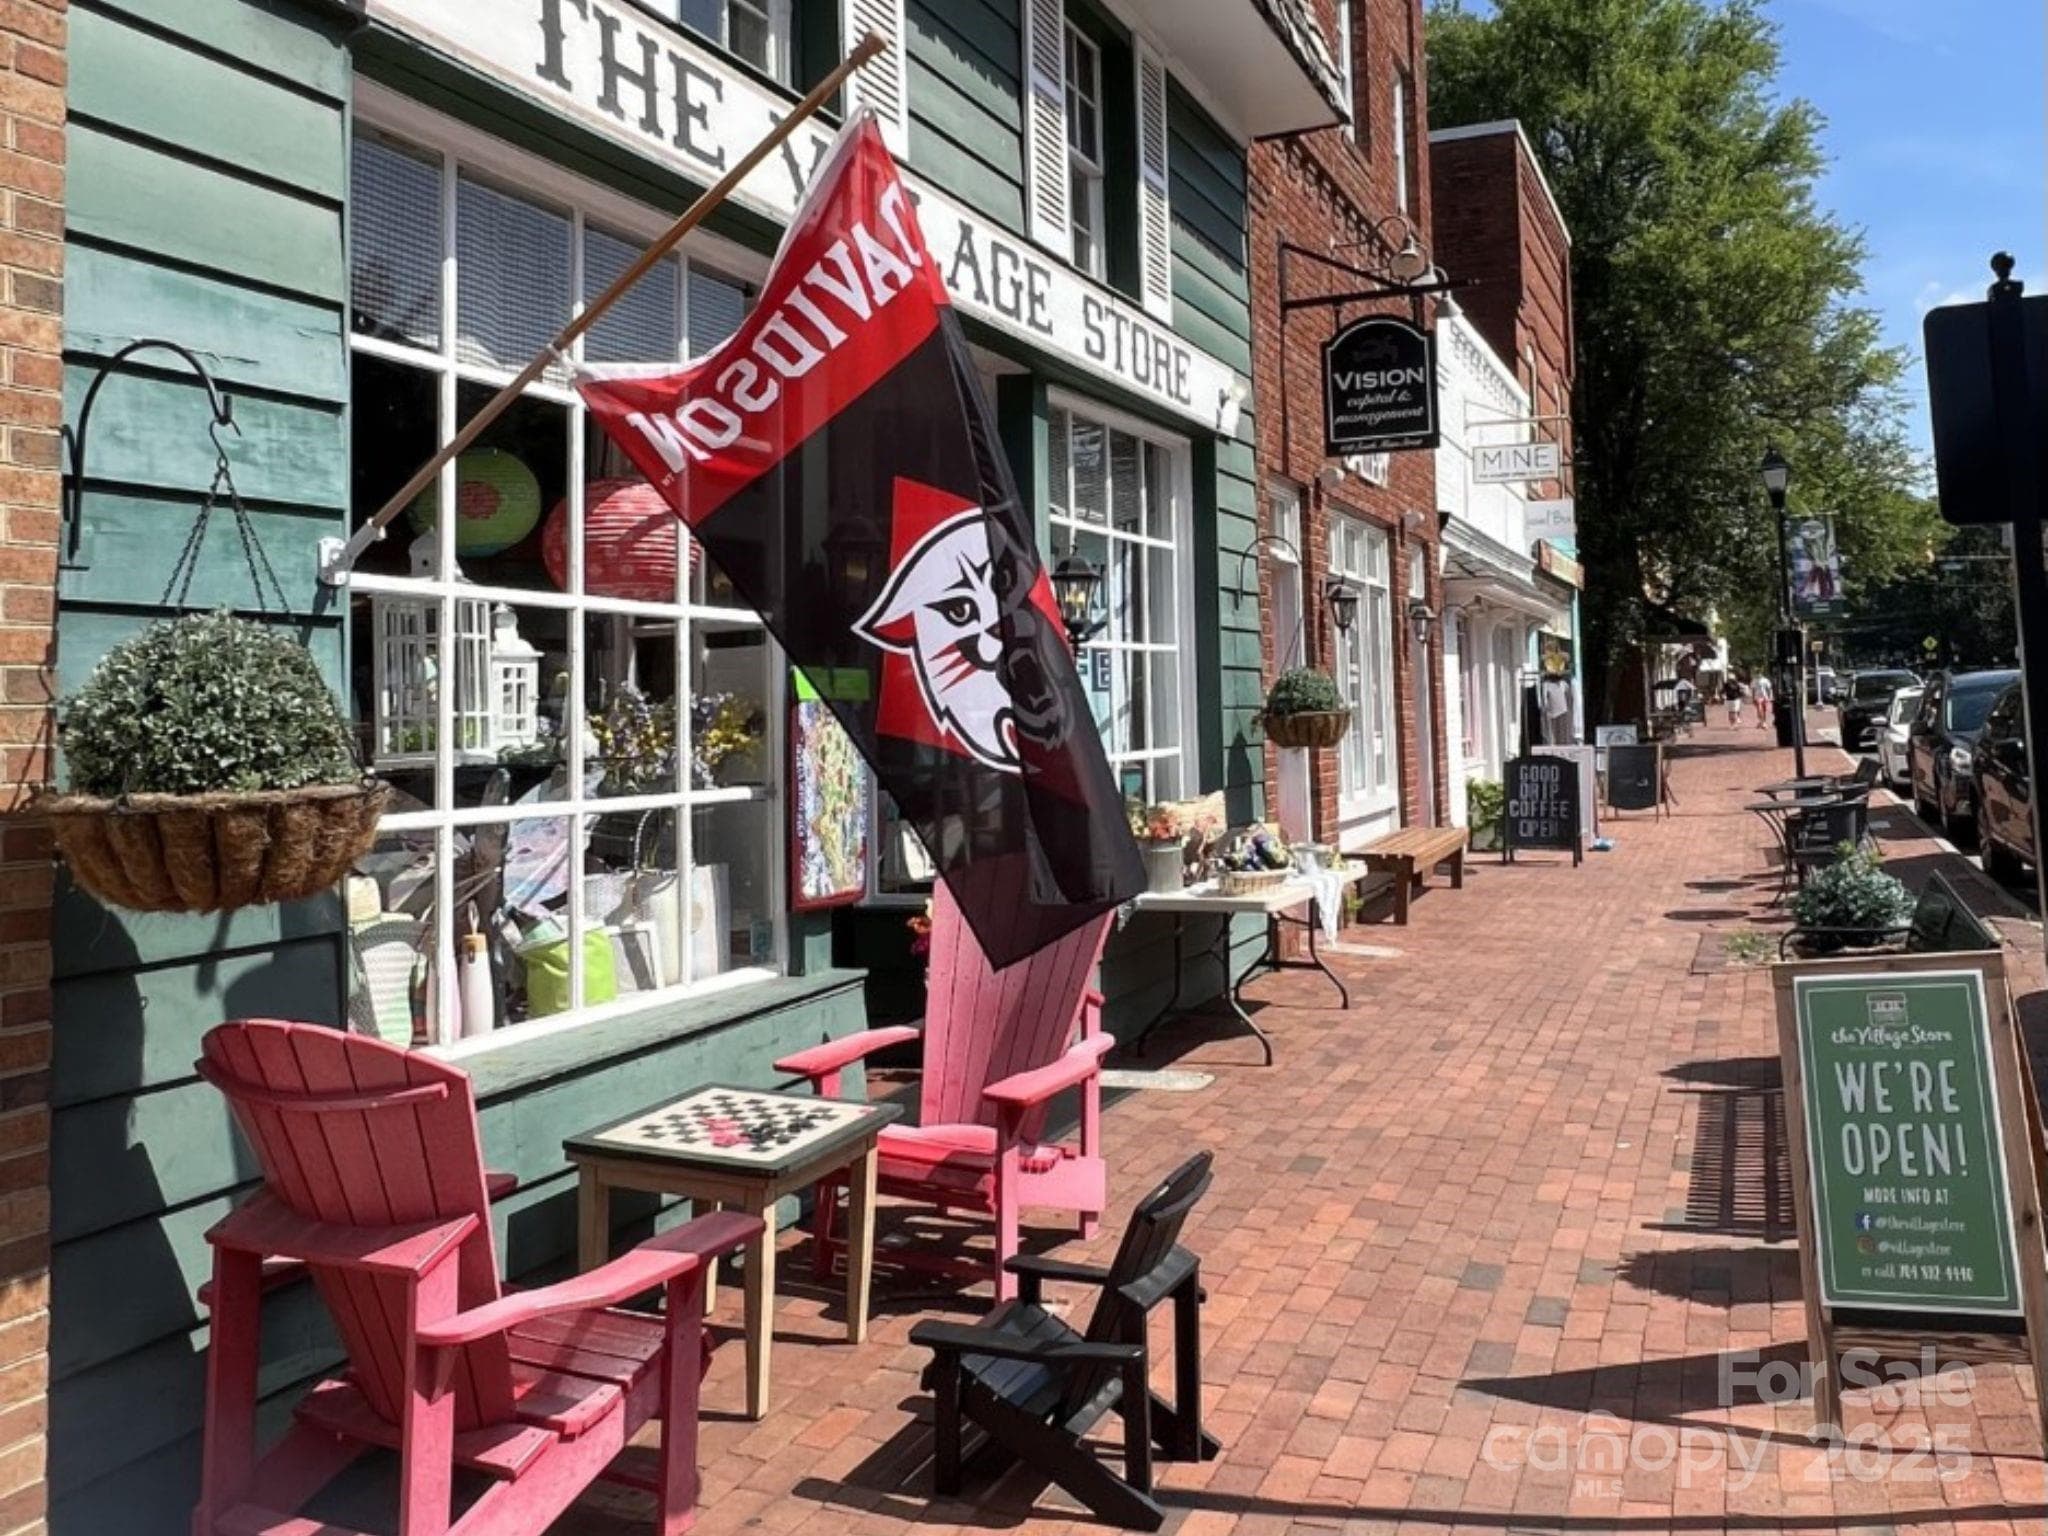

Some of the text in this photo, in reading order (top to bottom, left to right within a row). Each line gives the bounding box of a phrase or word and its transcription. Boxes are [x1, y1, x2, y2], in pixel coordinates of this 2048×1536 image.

[535, 0, 1191, 405] THE VAGE STORE
[1333, 366, 1425, 390] VISION
[1482, 446, 1550, 470] MINE
[1519, 765, 1560, 782] GOOD
[1519, 782, 1560, 799] DRIP
[1508, 800, 1570, 818] COFFEE
[1518, 818, 1560, 837] OPEN
[1831, 1024, 1953, 1049] the Village Store
[1834, 1059, 1961, 1114] WE'RE
[1841, 1122, 1969, 1177] OPEN!
[1863, 1187, 1949, 1205] MORE INFO AT
